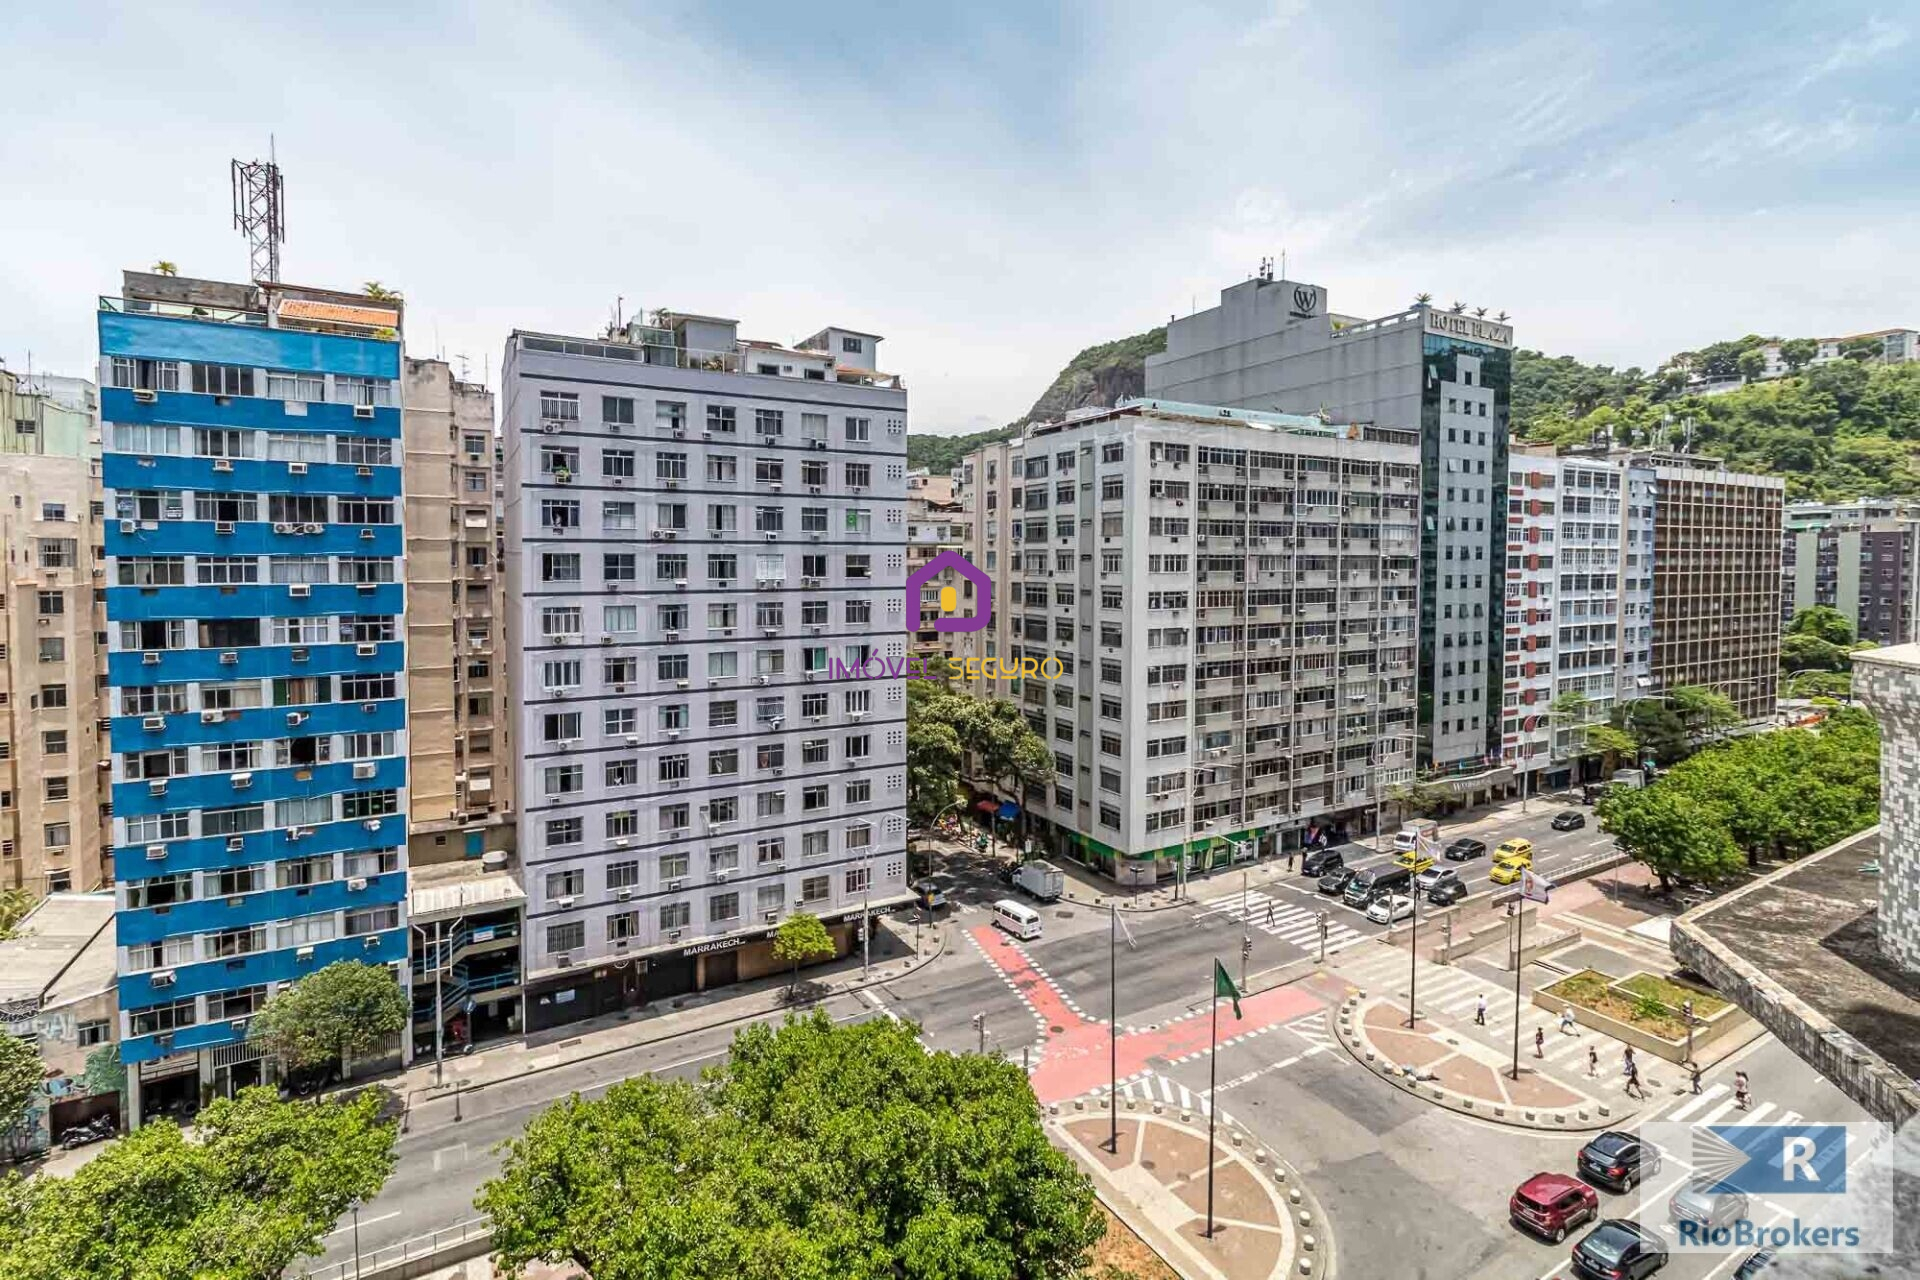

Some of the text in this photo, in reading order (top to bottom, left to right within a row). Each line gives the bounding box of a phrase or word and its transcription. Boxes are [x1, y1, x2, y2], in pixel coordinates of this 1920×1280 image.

[1430, 313, 1510, 345] HOTEL PLAZA
[683, 938, 740, 957] MARRAKECH
